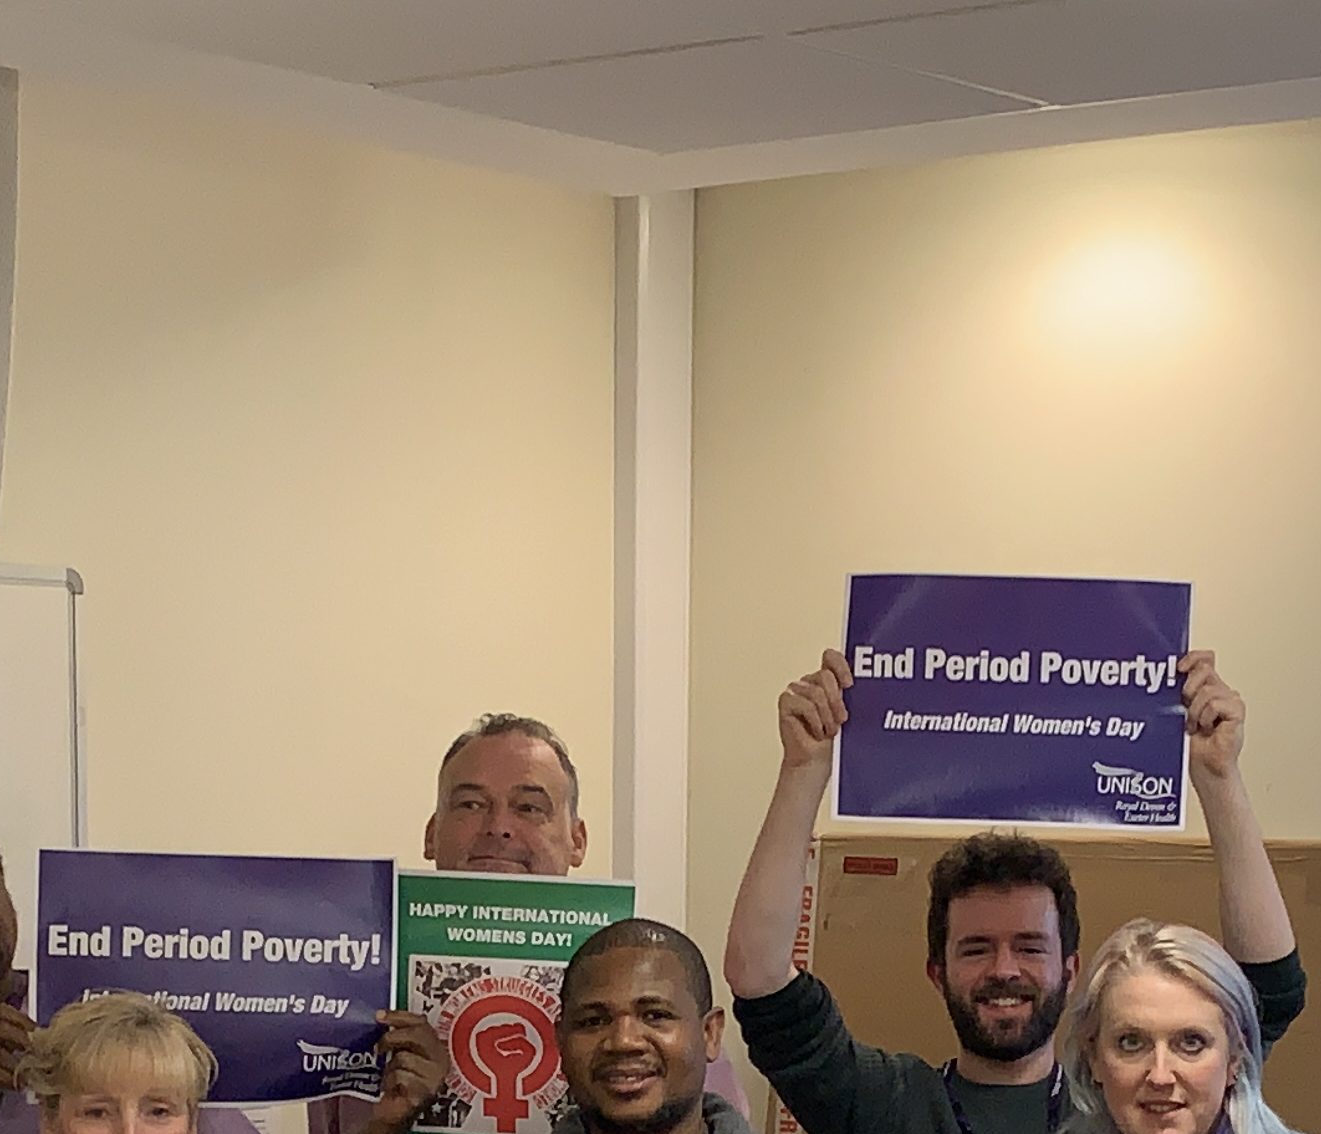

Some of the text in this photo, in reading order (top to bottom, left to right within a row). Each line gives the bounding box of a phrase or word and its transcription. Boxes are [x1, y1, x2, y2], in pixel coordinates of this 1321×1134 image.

[854, 646, 1177, 693] End Period Poverty!
[884, 710, 1144, 740] International Women's Day
[1097, 776, 1173, 795] UNISON
[410, 903, 612, 926] HAPPY INTERNATIONAL
[48, 925, 380, 970] End Period Poverty!
[448, 928, 572, 946] WOMENS DAY!
[216, 992, 305, 1013] Women's
[310, 995, 349, 1018] Day
[303, 1044, 378, 1072] UNISON
